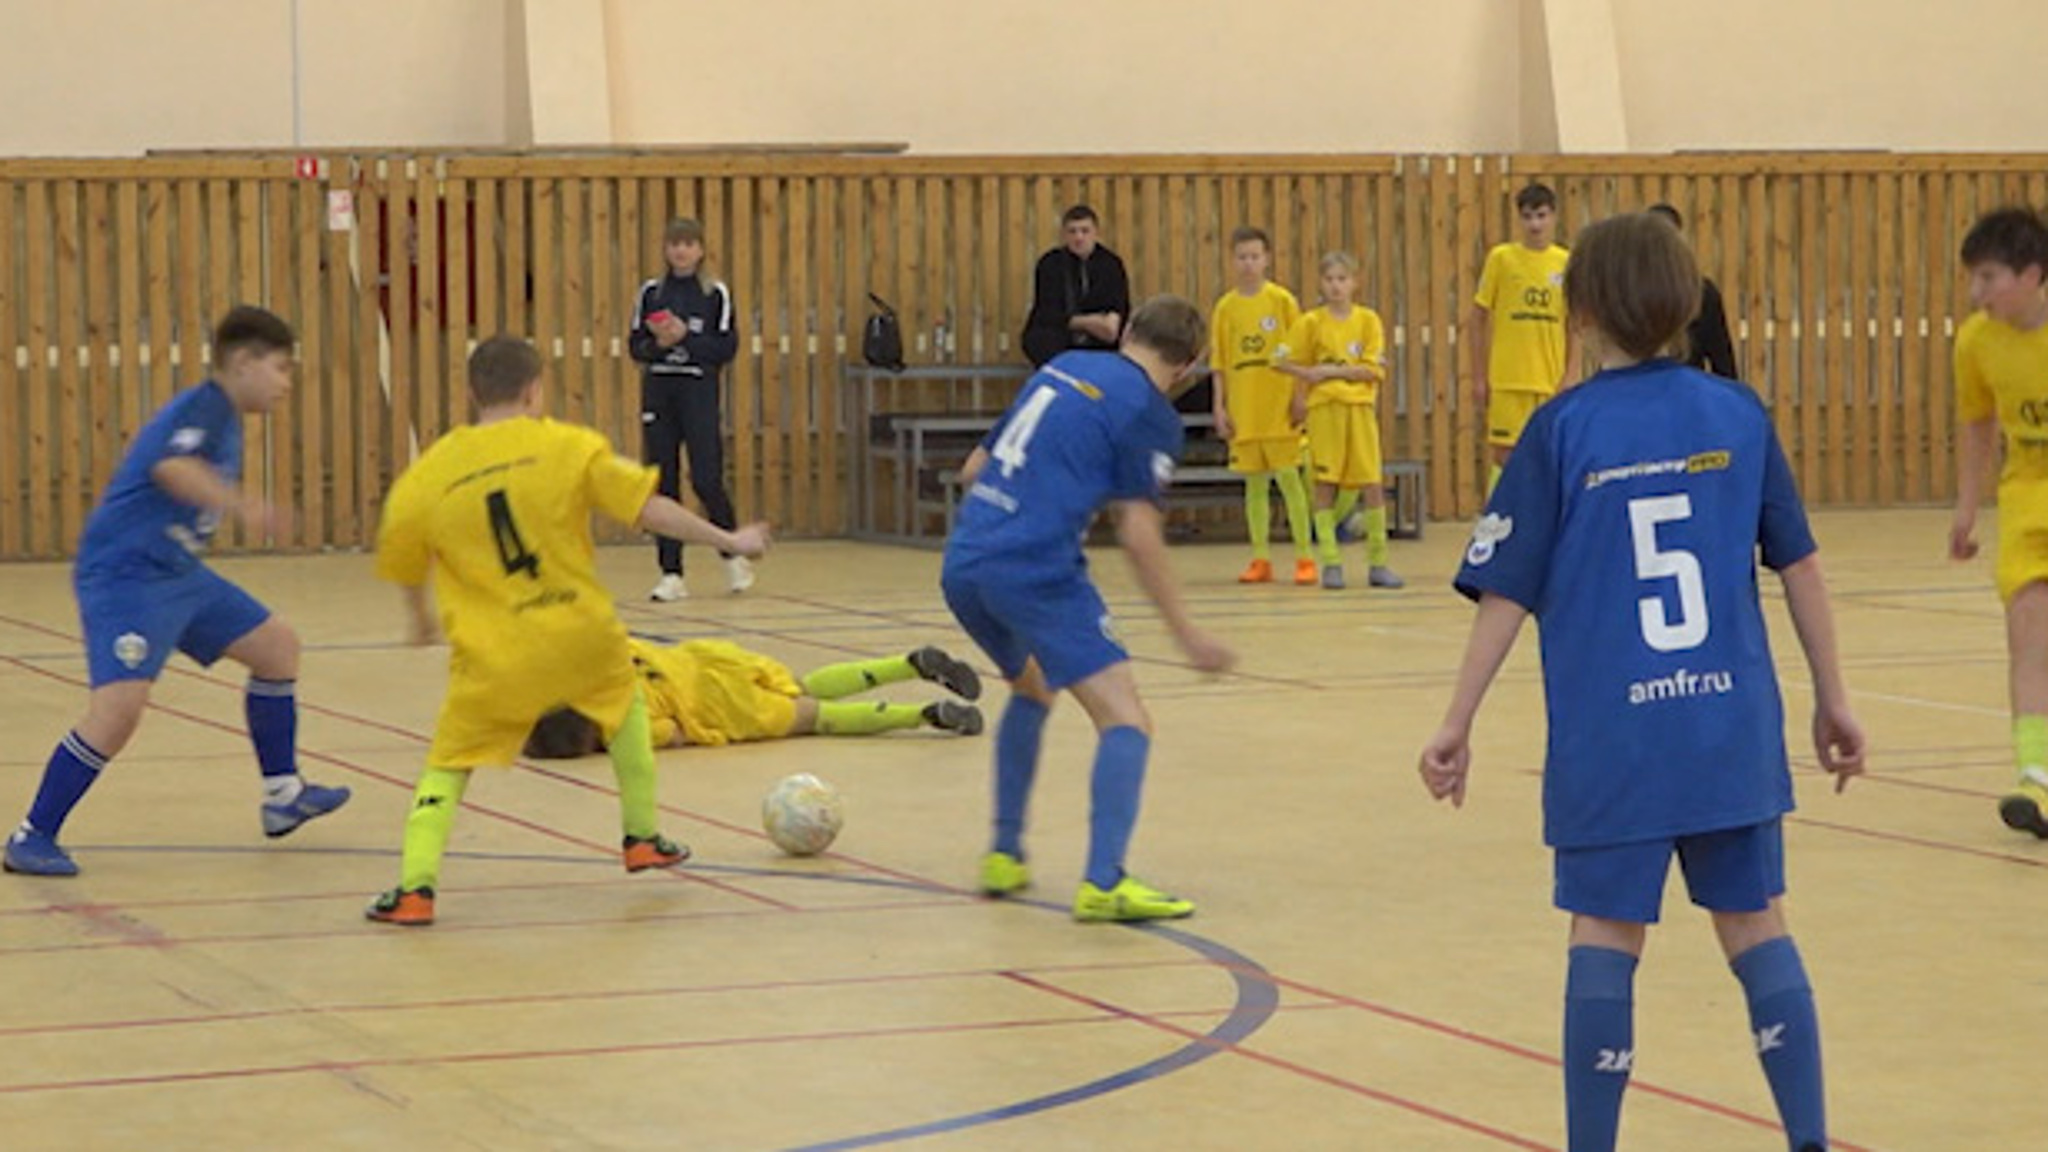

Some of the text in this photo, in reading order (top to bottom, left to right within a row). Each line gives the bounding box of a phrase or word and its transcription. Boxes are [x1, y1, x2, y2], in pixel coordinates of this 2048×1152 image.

[992, 384, 1057, 478] 4
[486, 489, 539, 580] 4
[1628, 494, 1709, 652] 5
[1629, 669, 1733, 703] amfr.ru
[1595, 1048, 1634, 1071] 2K
